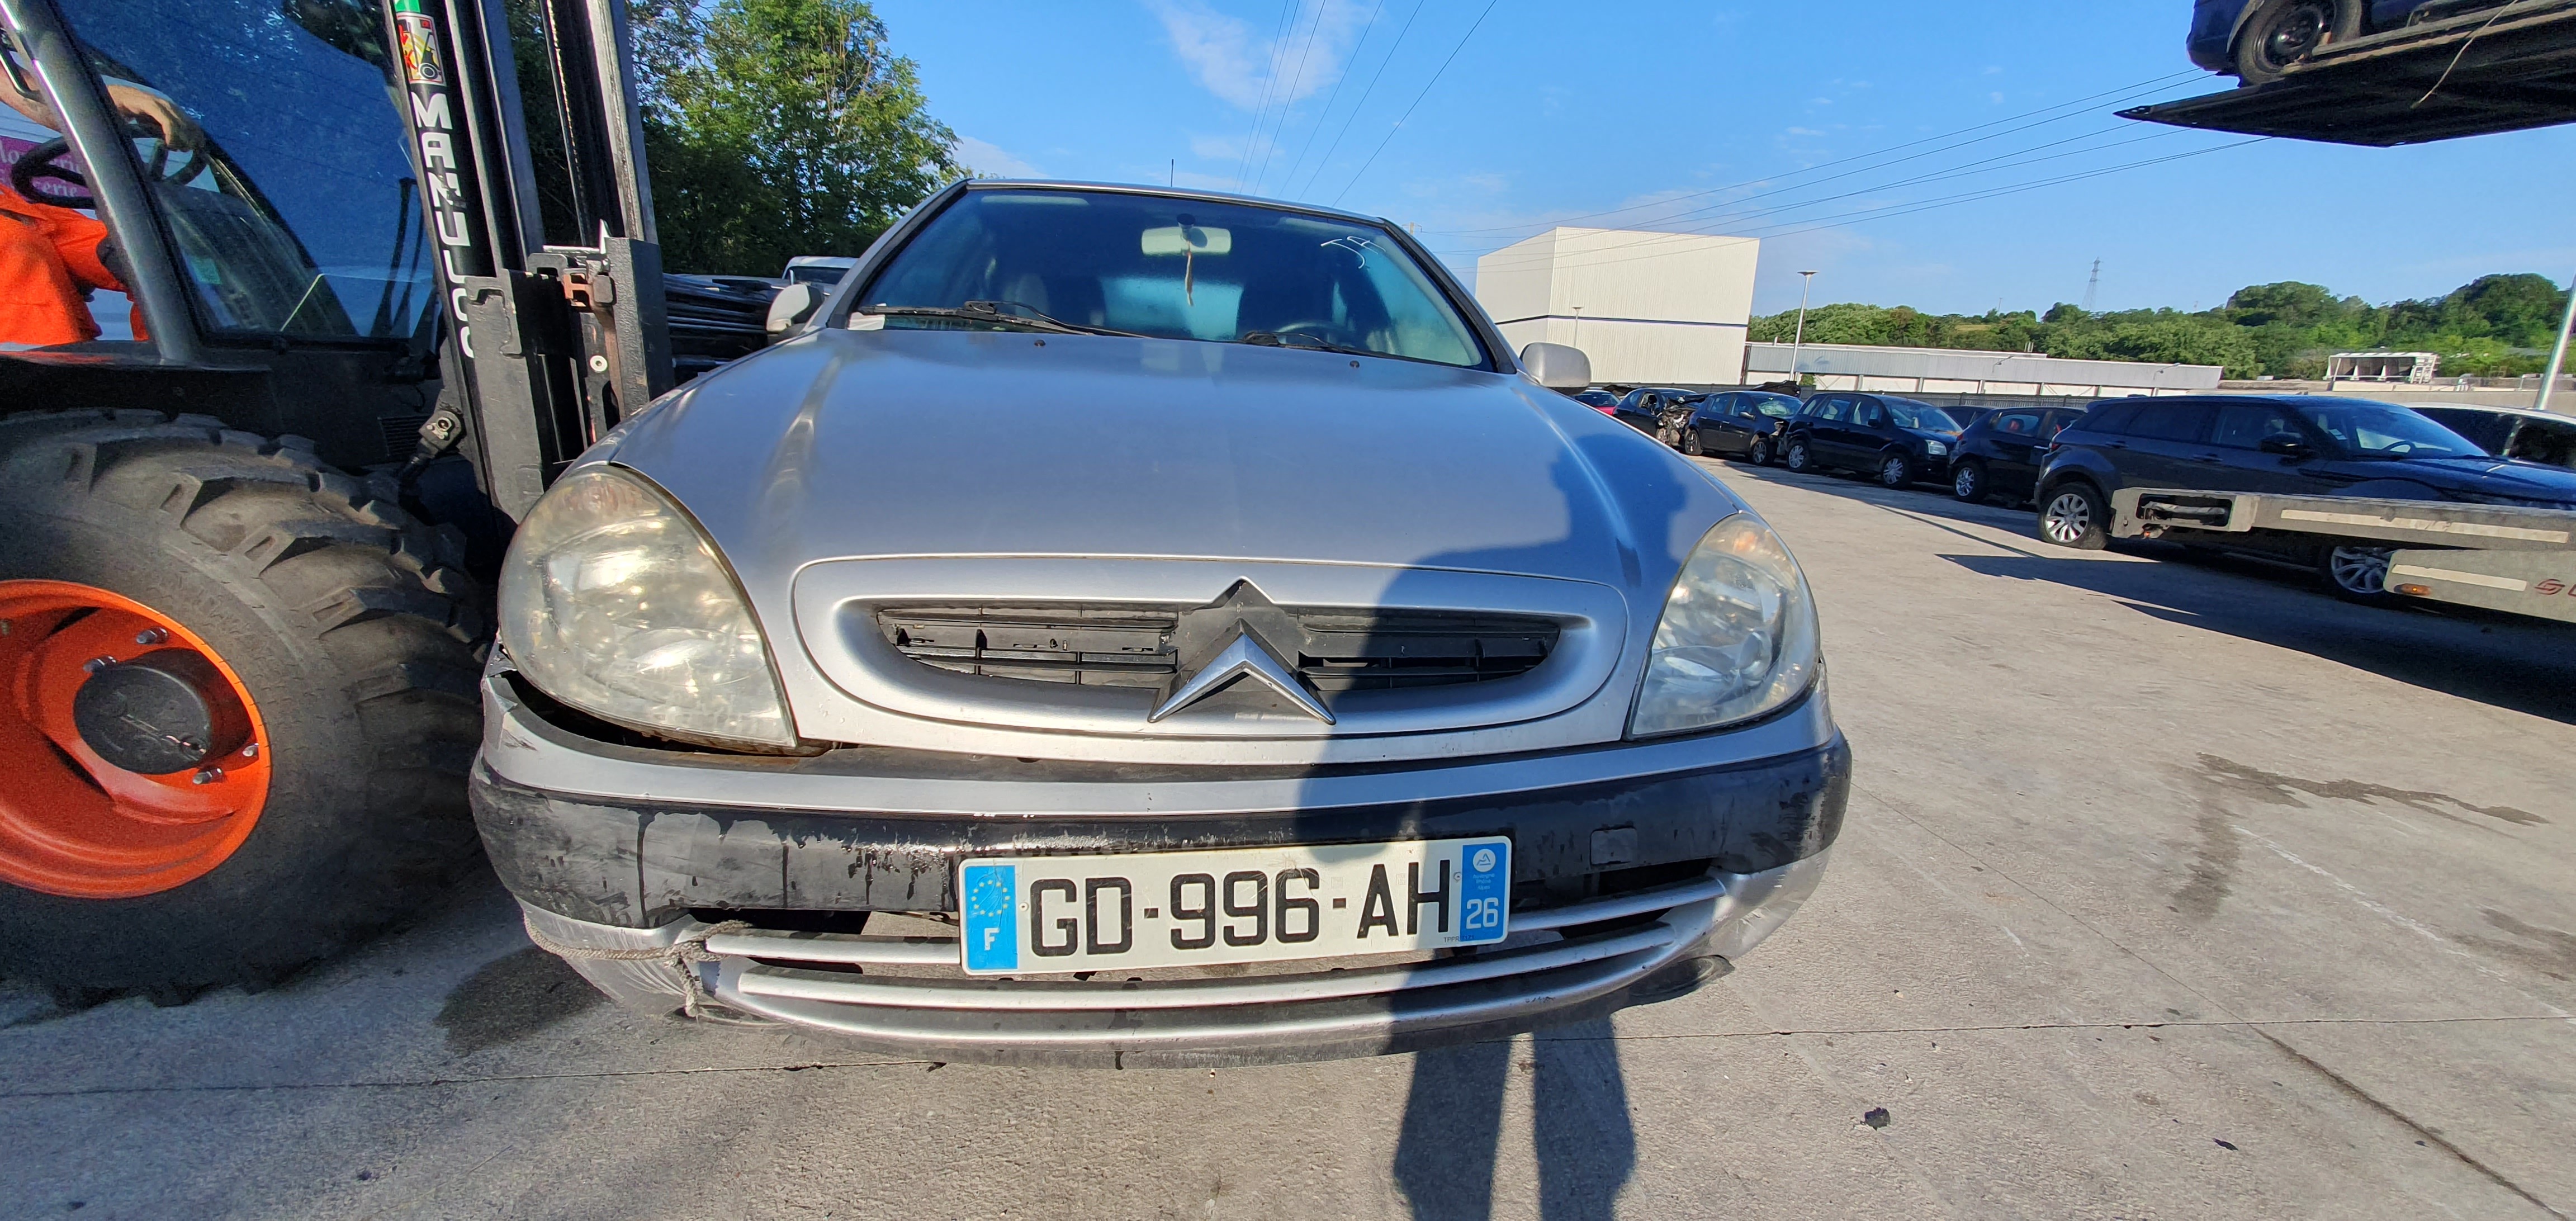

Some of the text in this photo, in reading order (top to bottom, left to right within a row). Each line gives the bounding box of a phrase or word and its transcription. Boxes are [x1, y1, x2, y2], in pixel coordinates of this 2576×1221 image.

[1030, 859, 1451, 957] GD-996-AH
[1466, 897, 1499, 929] 26
[984, 927, 1000, 950] F
